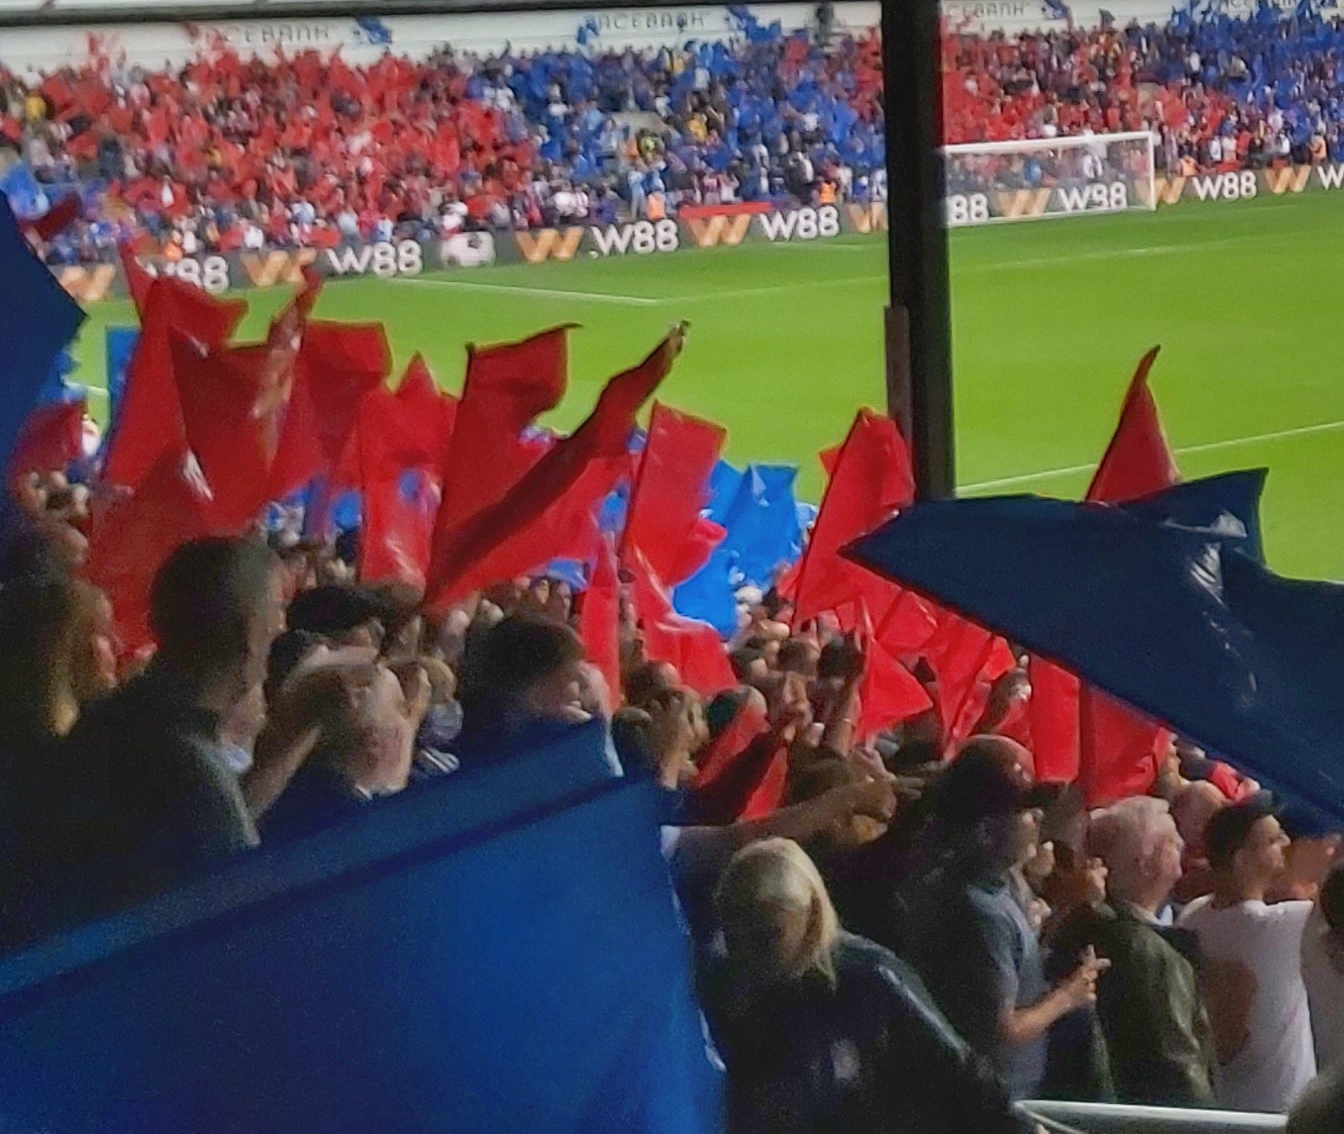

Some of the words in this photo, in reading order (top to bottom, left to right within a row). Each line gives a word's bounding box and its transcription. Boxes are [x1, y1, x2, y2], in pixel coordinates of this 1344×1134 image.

[1057, 180, 1128, 214] W88
[1192, 170, 1258, 202] W88
[326, 239, 424, 279] W88
[591, 217, 681, 256] W88
[759, 205, 841, 241] W88
